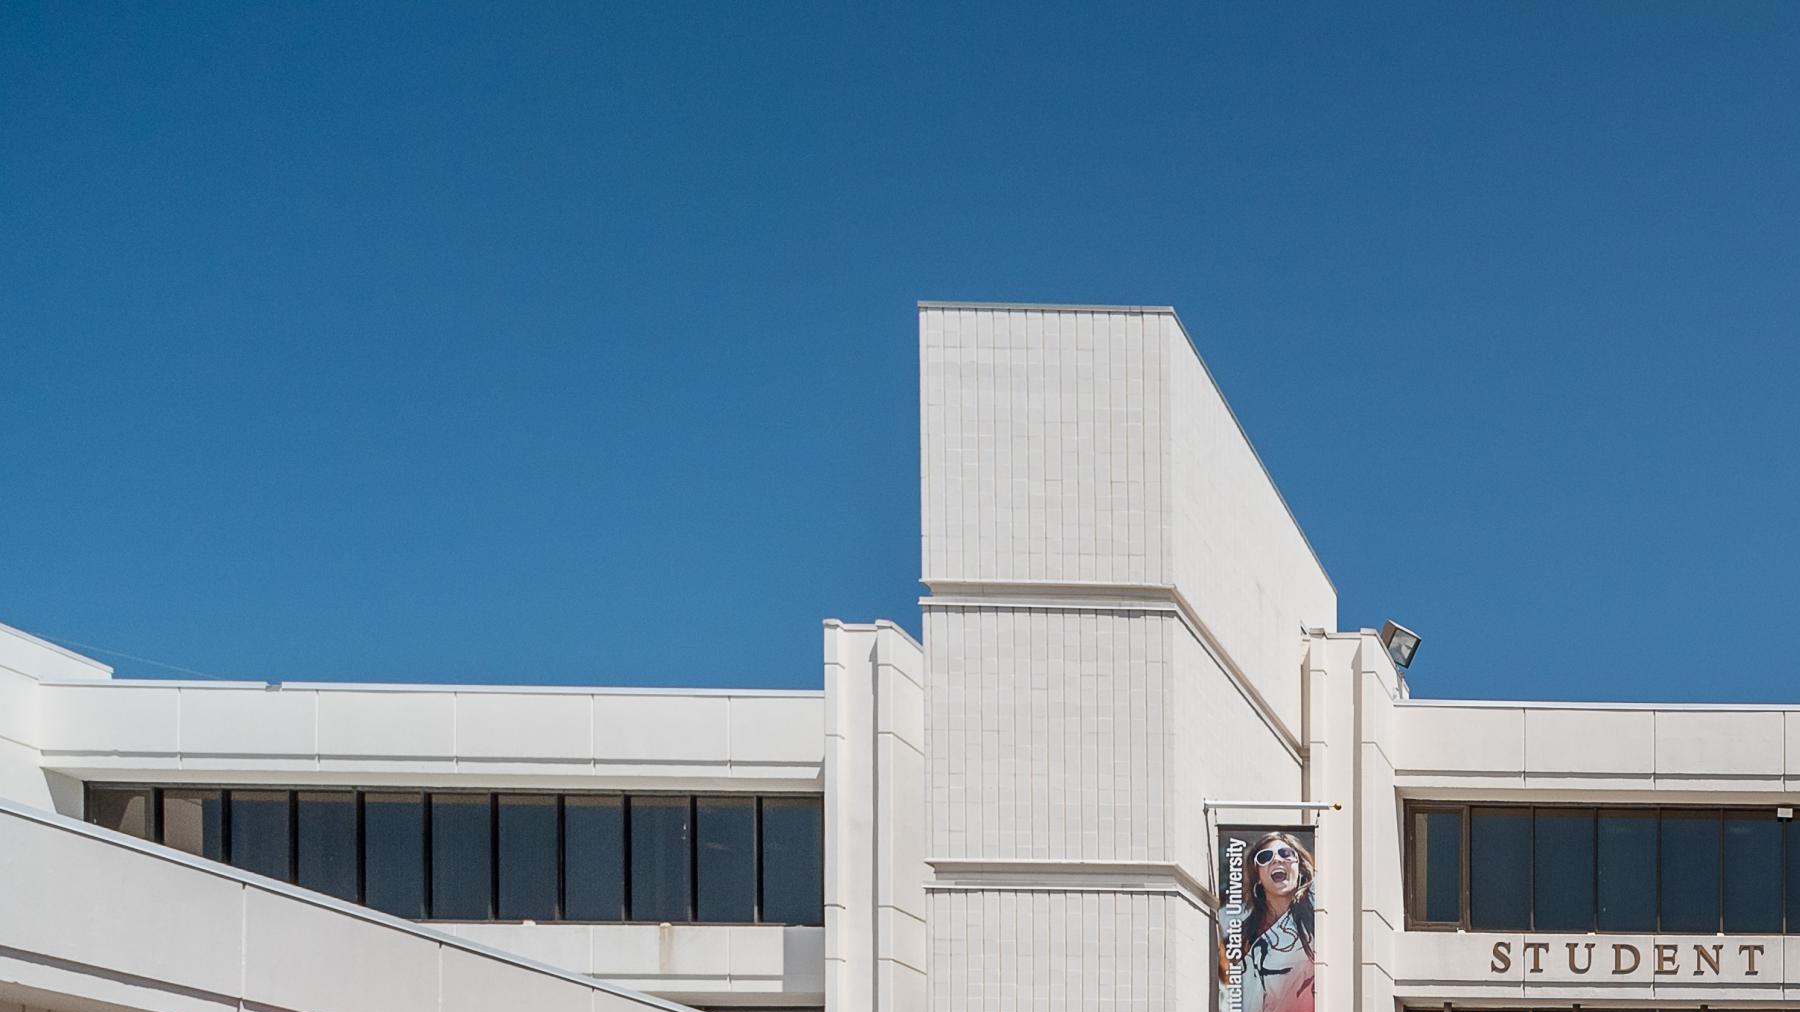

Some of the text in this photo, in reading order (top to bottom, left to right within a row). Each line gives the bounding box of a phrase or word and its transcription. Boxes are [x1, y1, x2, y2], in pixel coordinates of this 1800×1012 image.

[1225, 837, 1247, 916] University
[1225, 918, 1243, 961] State
[1490, 941, 1765, 976] STUDENT
